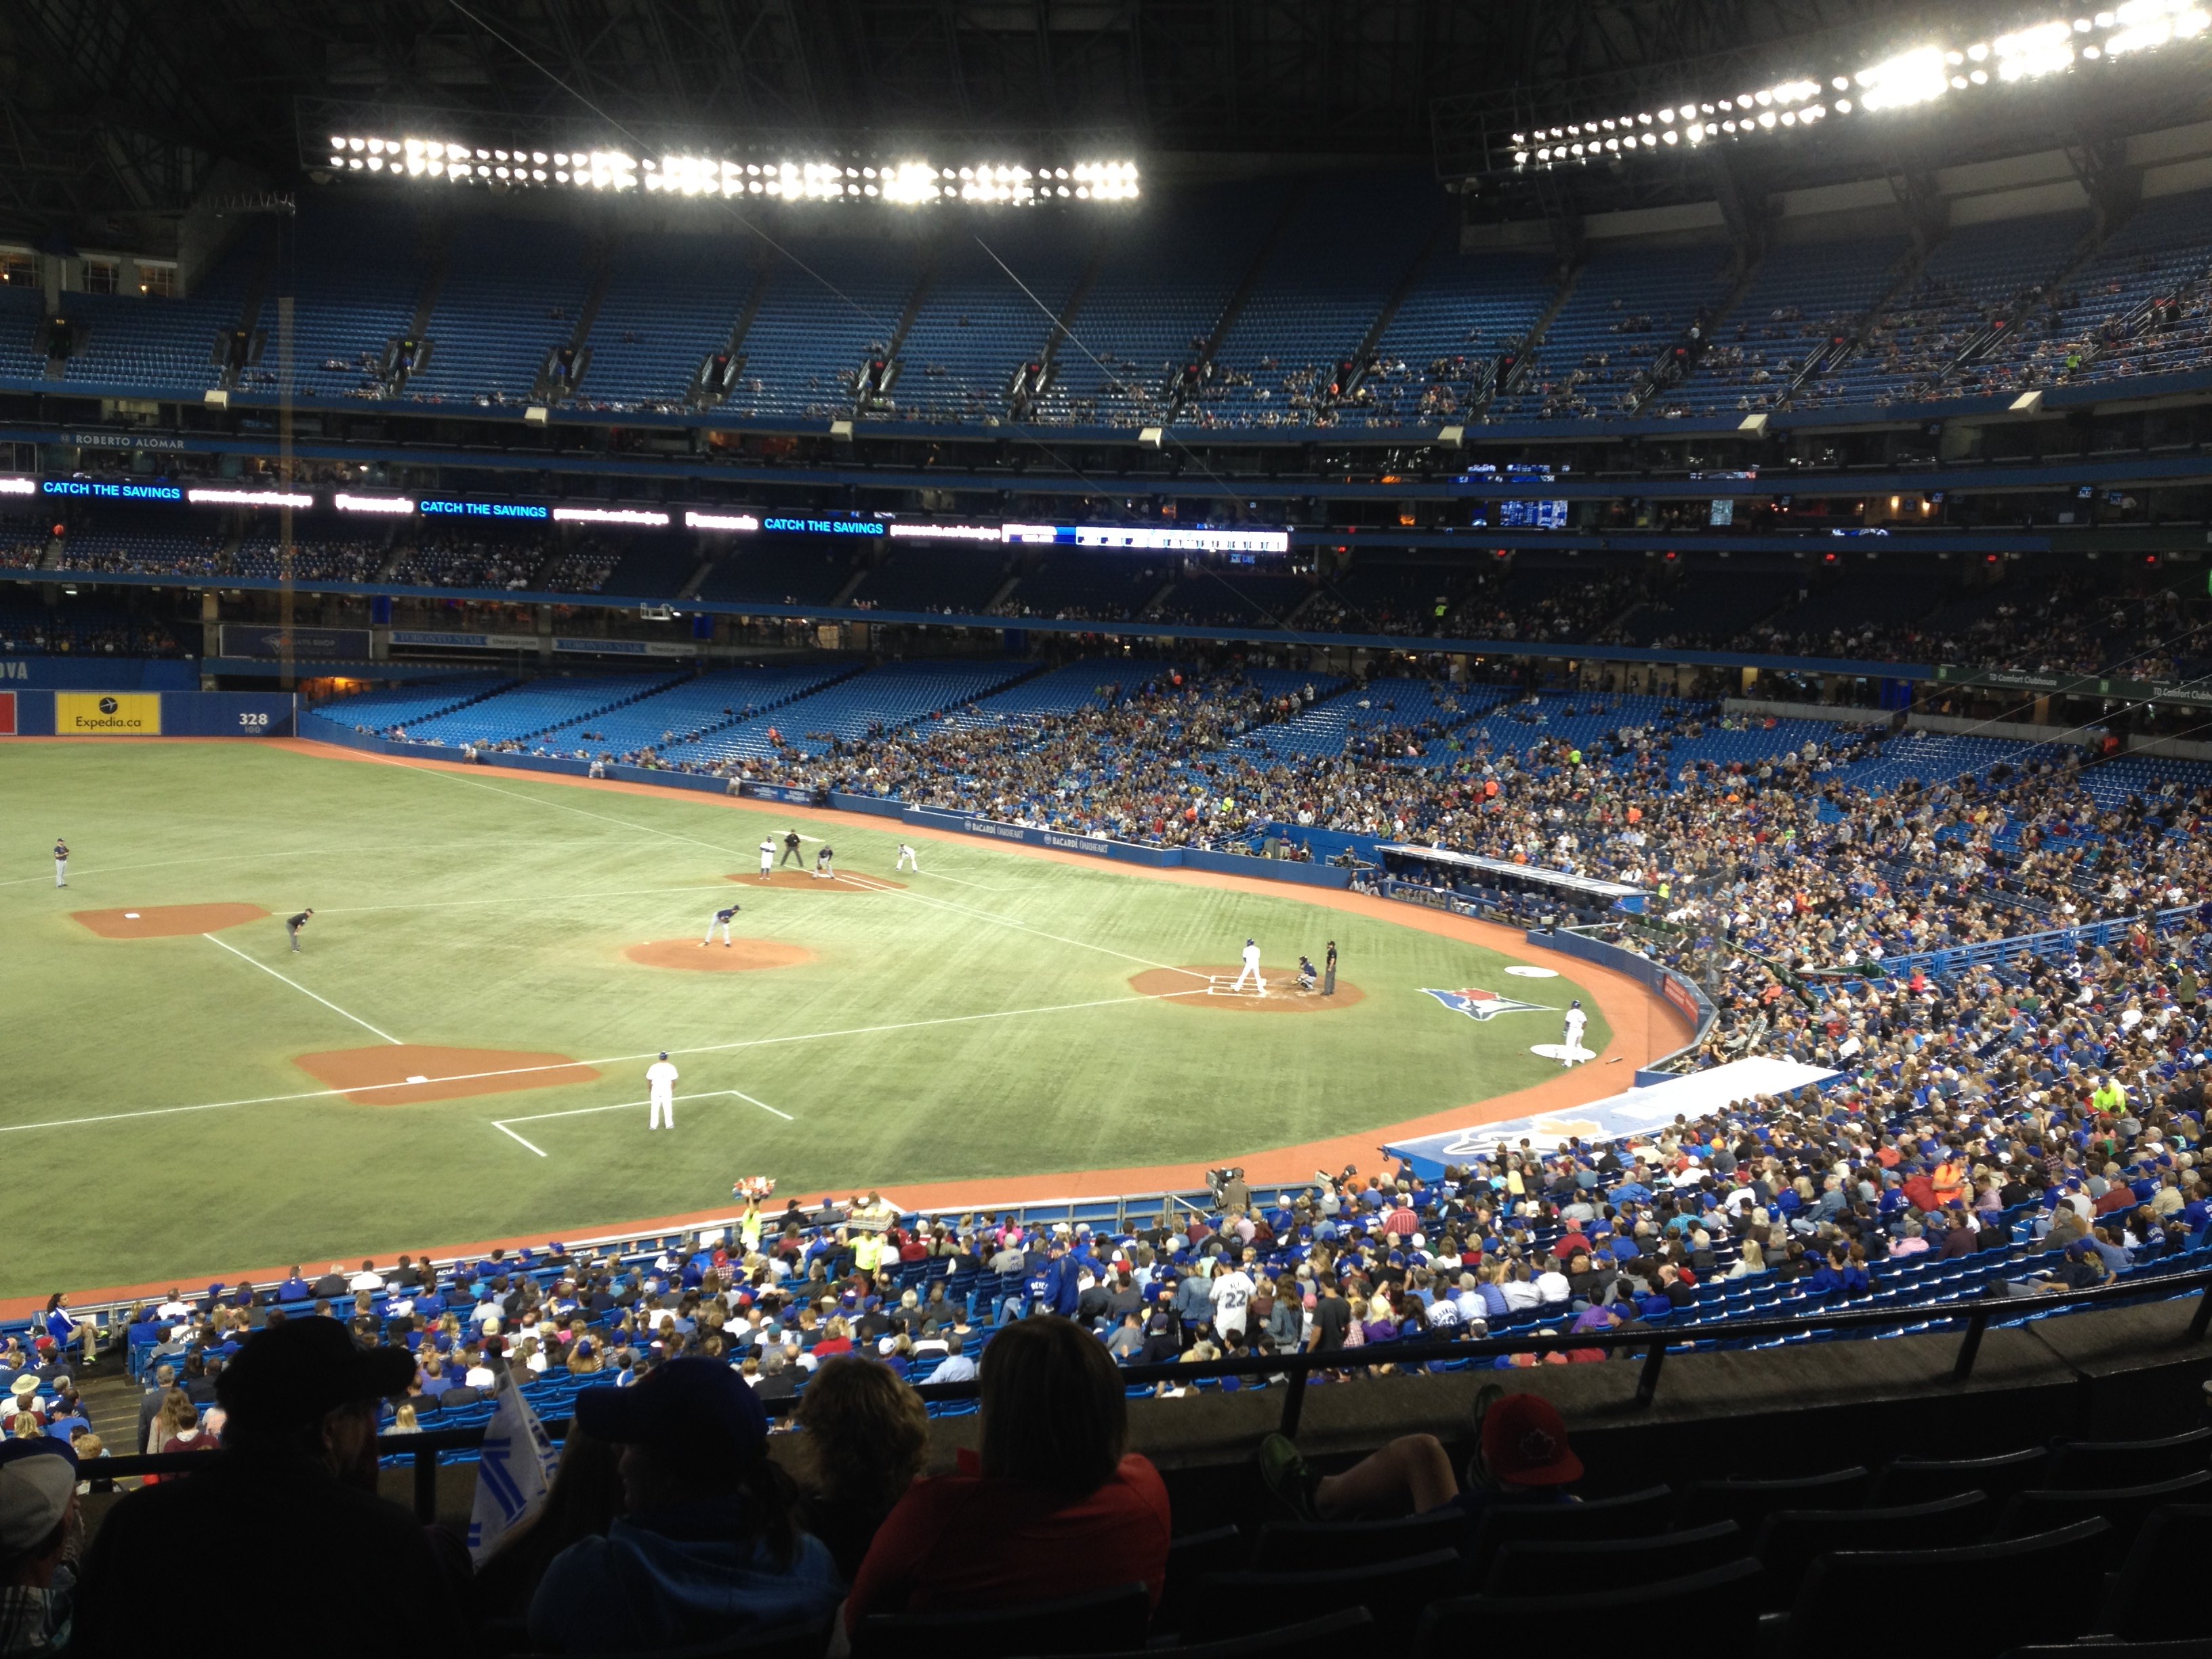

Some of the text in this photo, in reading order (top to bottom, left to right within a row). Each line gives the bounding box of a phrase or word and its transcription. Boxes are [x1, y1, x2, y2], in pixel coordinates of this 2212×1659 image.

[76, 434, 130, 446] ROBERTO
[136, 437, 184, 449] ALOMAR
[43, 482, 89, 495] CATCH
[93, 484, 119, 495] THE
[123, 485, 180, 499] SAVINGS
[420, 501, 462, 513] CATCH
[466, 504, 491, 514] THE
[493, 505, 546, 517] SAVINGS
[764, 518, 804, 531] CATCH
[807, 520, 831, 532] THE
[833, 521, 884, 534] SAVINGS
[1998, 674, 2023, 683] Comfort
[2024, 676, 2057, 686] Clubhouse
[2153, 687, 2162, 695] TD
[76, 716, 141, 729] Expedia.ca
[239, 714, 268, 725] 328
[997, 825, 1024, 839] OAKHEART
[1079, 840, 1108, 853] OAKHEART
[1225, 1290, 1246, 1309] 22
